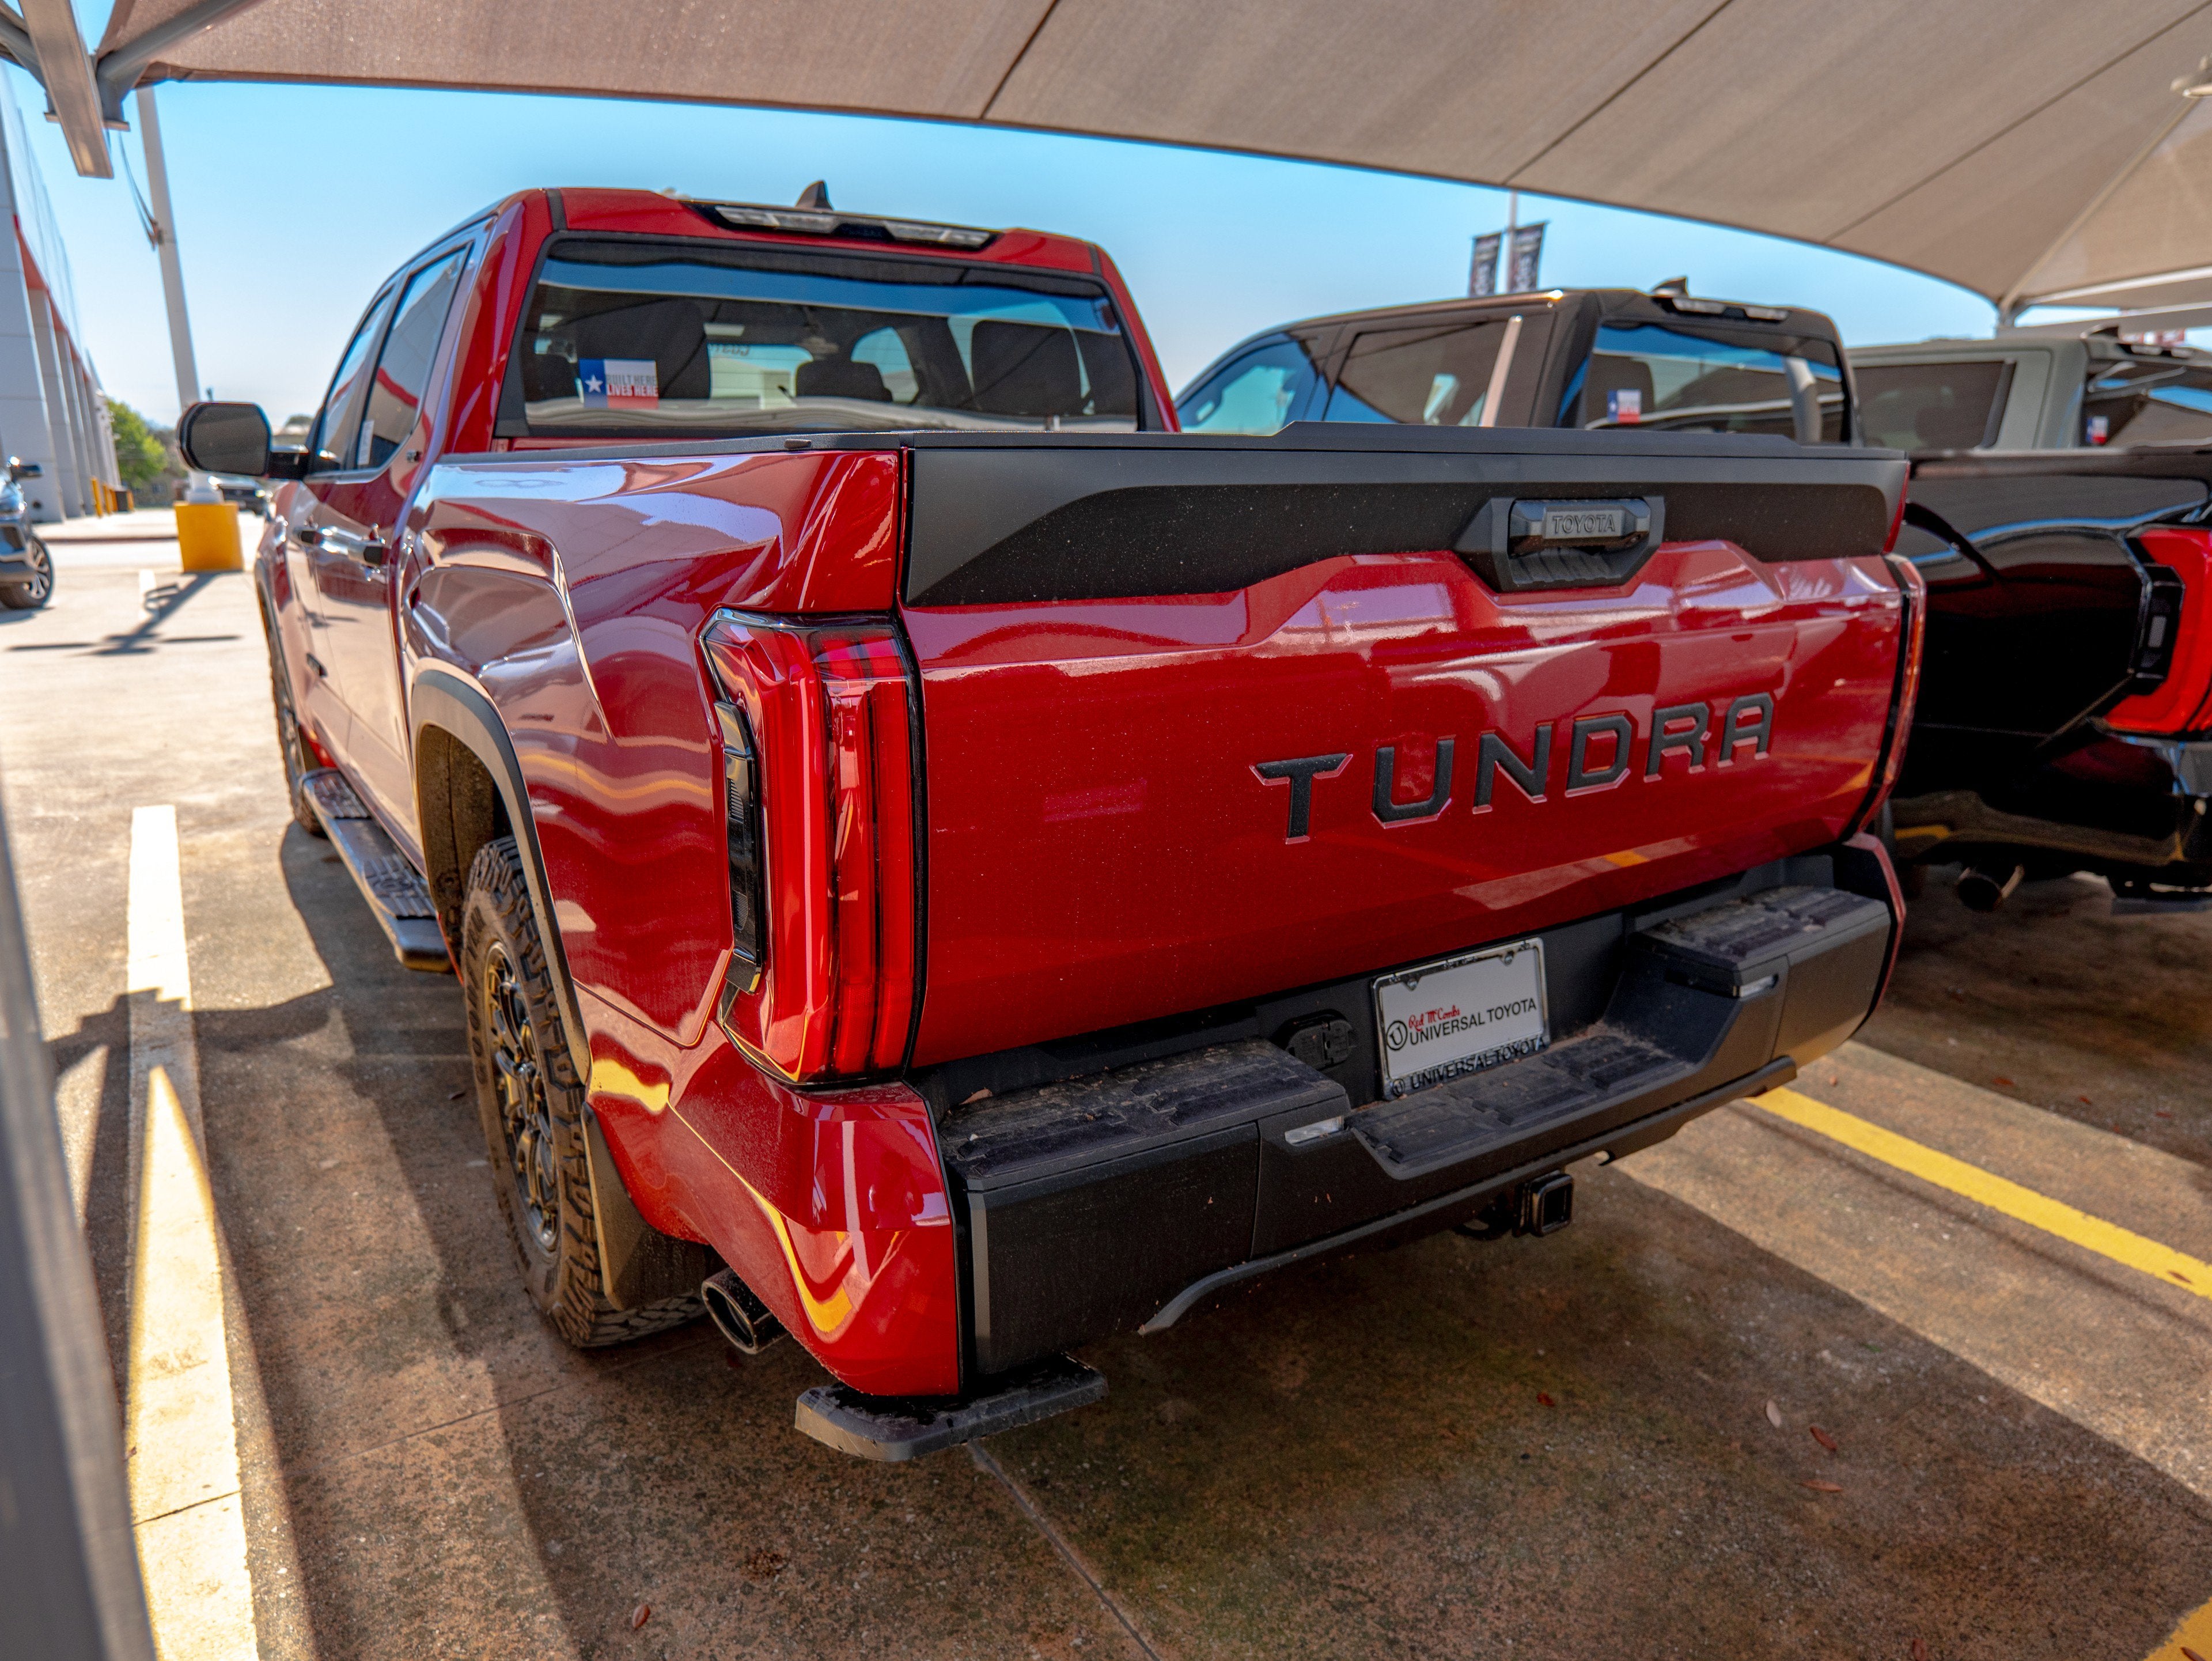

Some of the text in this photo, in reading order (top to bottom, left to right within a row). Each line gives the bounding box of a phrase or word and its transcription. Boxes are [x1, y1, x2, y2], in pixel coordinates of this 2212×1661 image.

[607, 384, 658, 397] LIVES HERE
[1553, 514, 1615, 534] TOYOTA
[1249, 693, 1774, 845] TUNDRA
[1408, 1013, 1425, 1032] Red
[1410, 997, 1537, 1045] UNIVERSAL TOYOTA
[1411, 1037, 1546, 1089] UNIVERSAL TOYOTA
